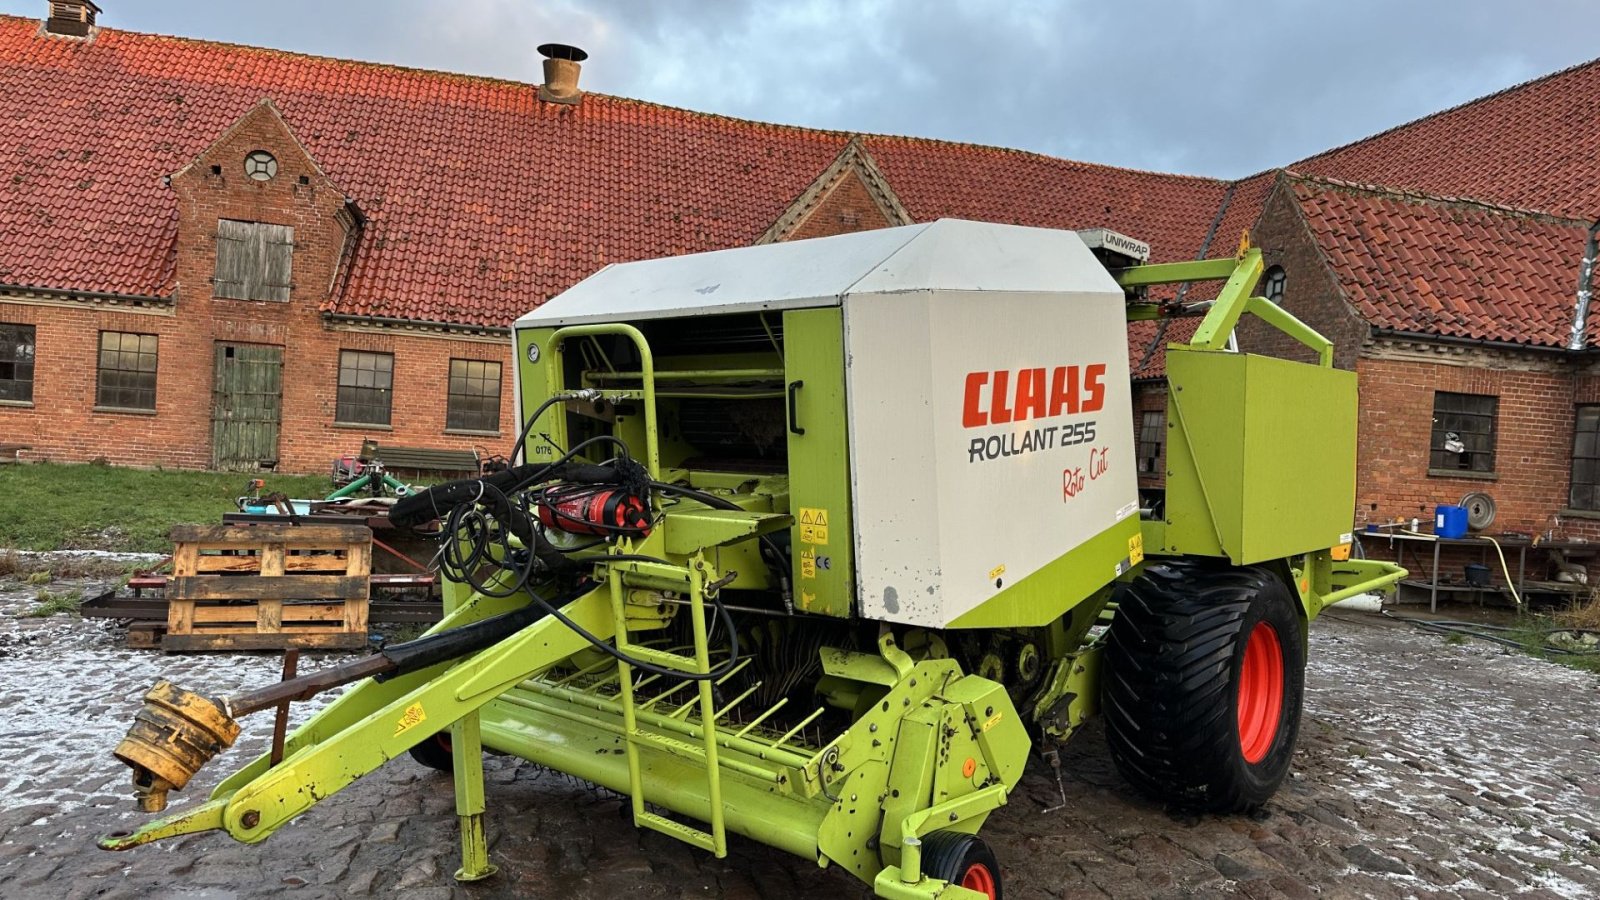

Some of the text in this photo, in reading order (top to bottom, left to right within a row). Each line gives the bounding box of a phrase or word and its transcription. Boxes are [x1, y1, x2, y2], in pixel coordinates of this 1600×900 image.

[1105, 234, 1148, 255] UNIWRAP
[962, 364, 1106, 429] CLAAS
[968, 421, 1096, 463] ROLLANT 255
[1063, 447, 1109, 503] Roto Cut
[816, 556, 830, 570] CE
